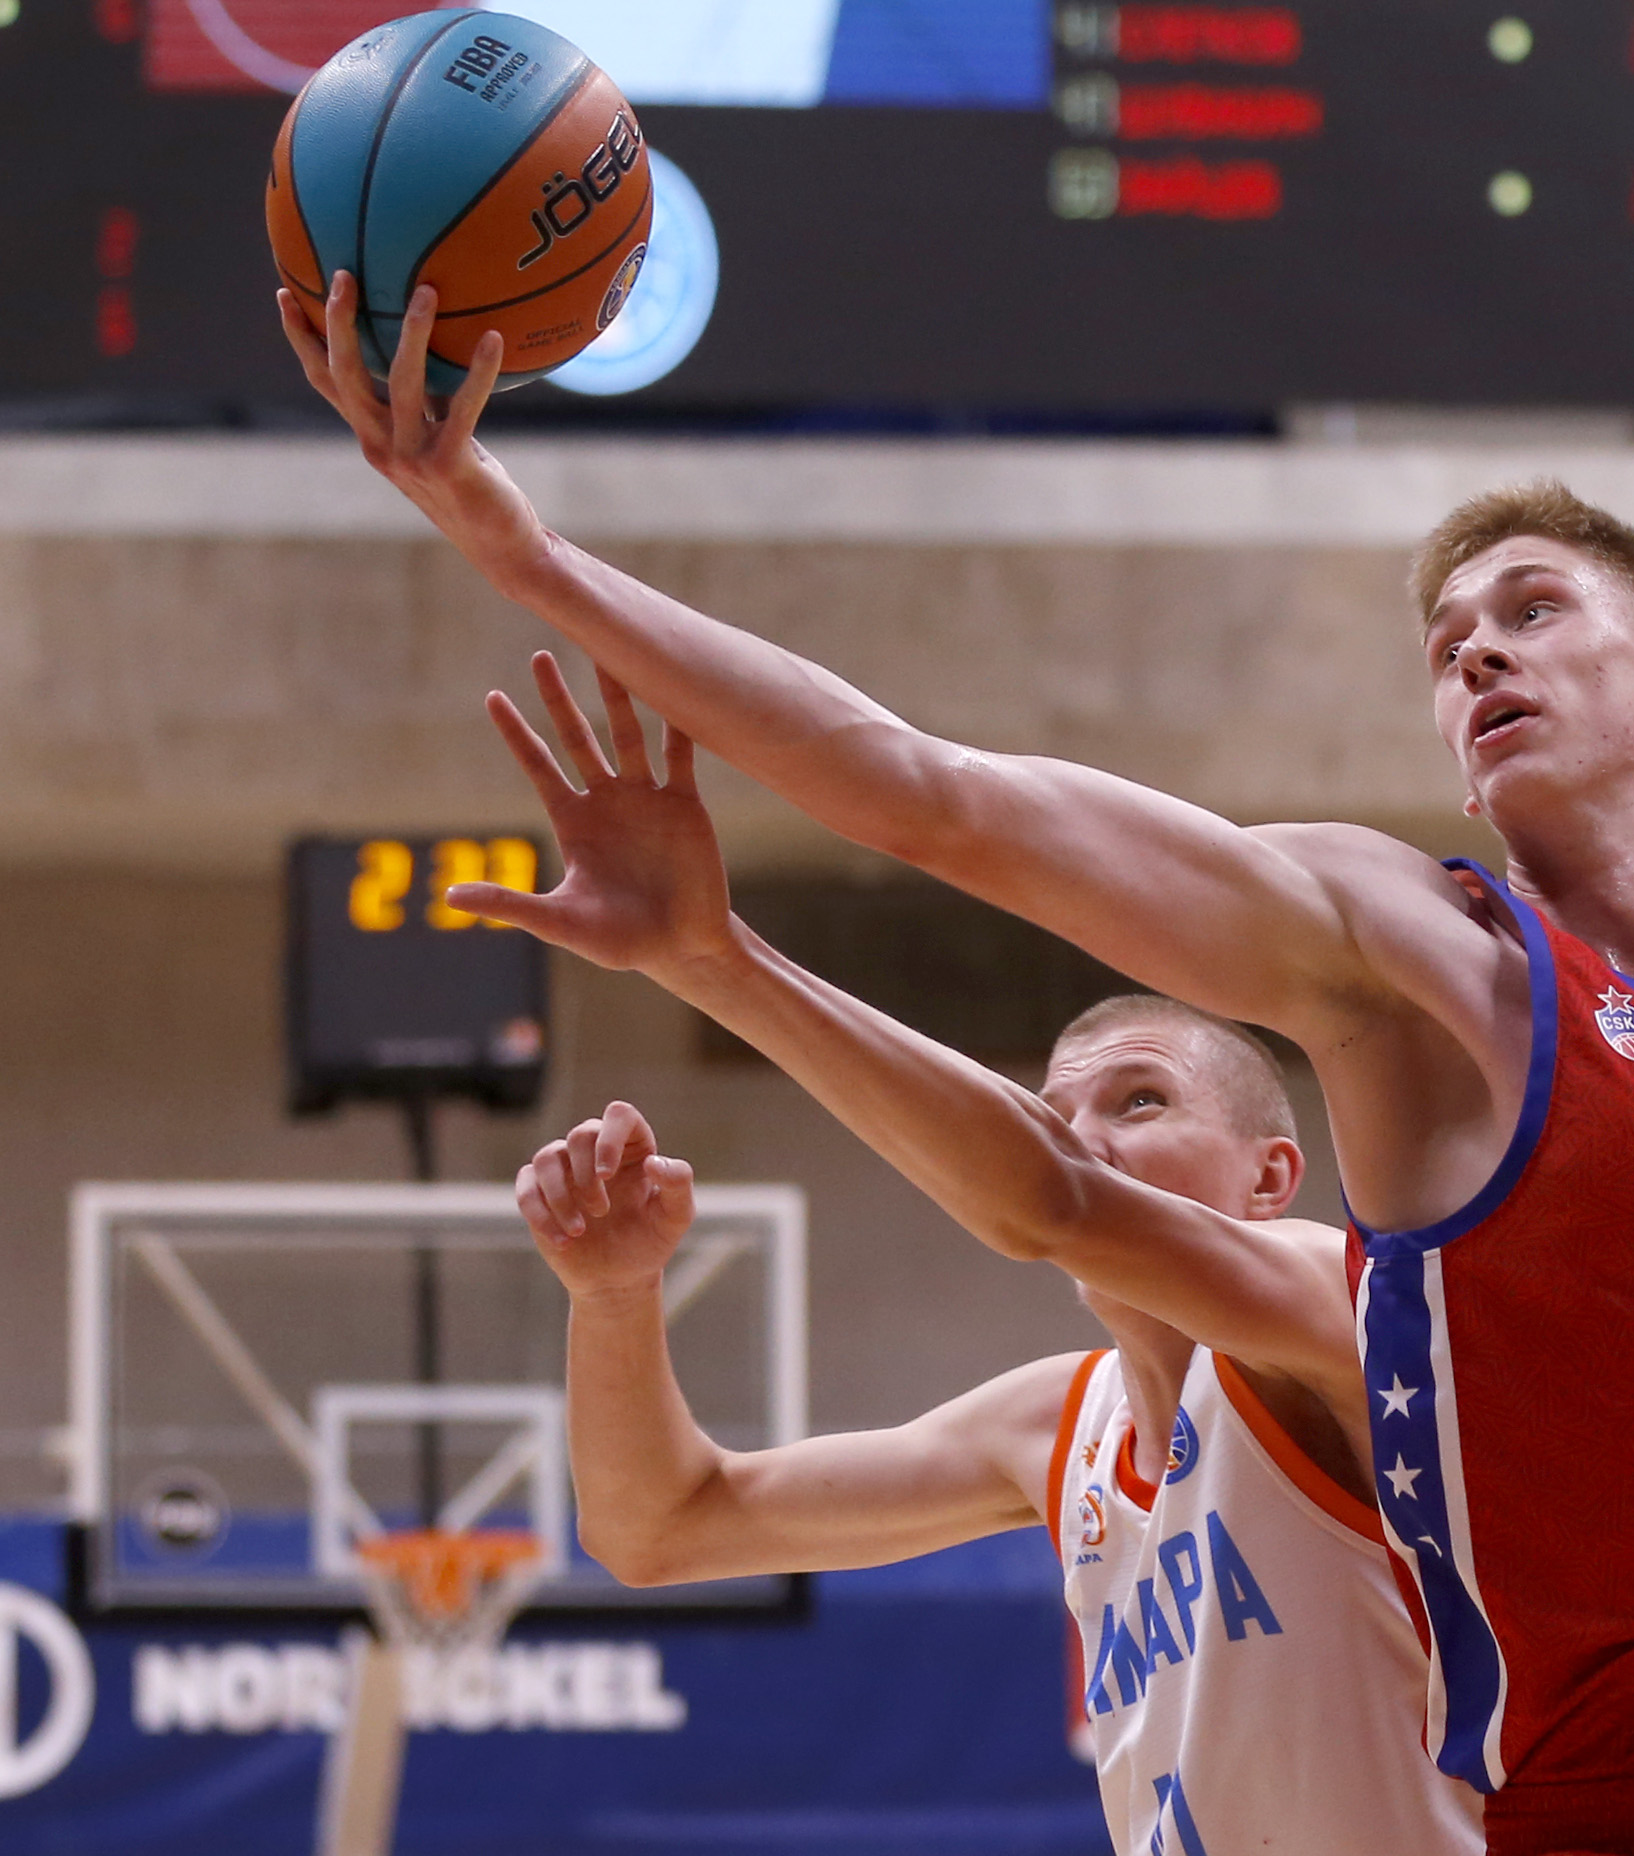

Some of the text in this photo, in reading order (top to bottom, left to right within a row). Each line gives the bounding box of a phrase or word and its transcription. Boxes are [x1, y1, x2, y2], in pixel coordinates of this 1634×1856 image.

[442, 36, 511, 93] FIBA
[480, 52, 528, 103] APPROVED
[132, 1640, 690, 1734] NORICKEL
